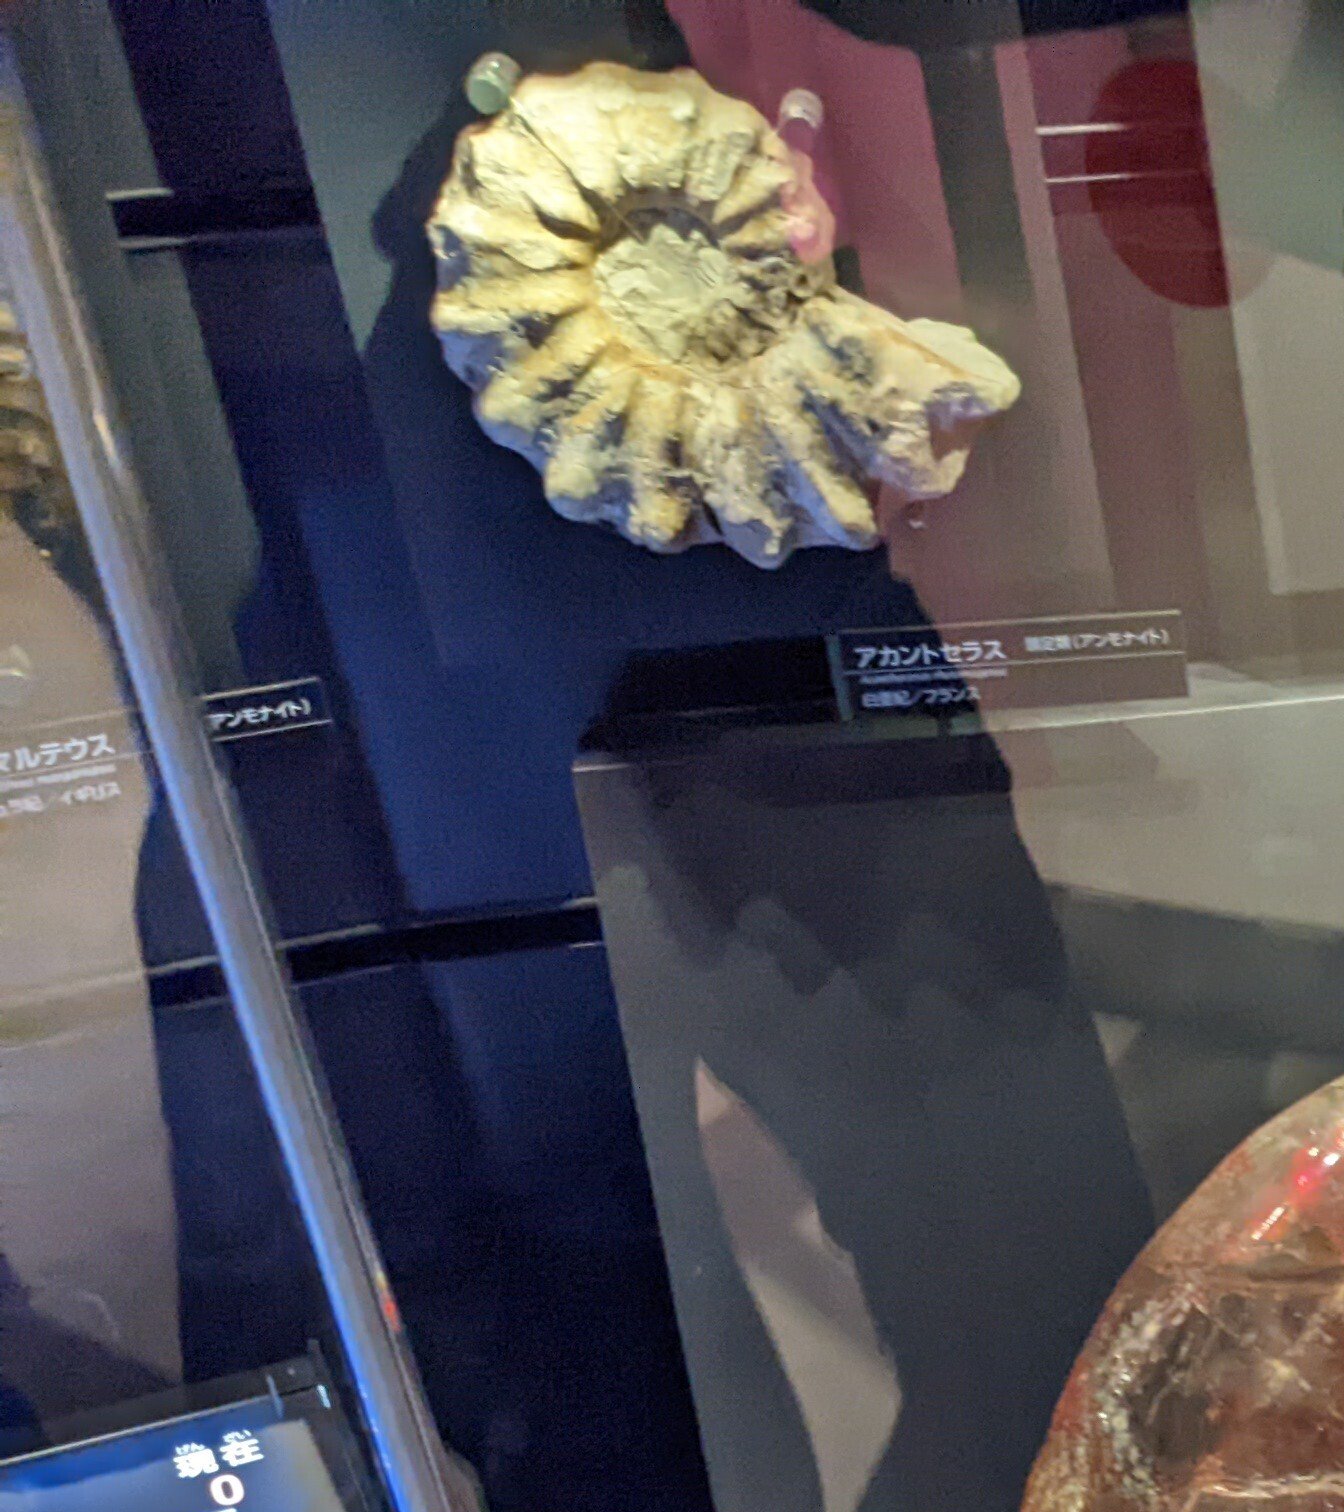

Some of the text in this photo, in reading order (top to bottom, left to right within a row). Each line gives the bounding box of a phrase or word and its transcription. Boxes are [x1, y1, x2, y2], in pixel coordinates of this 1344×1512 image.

[854, 628, 1169, 668] アカントセラス (アンモナイト)
[210, 1474, 244, 1506] 0
